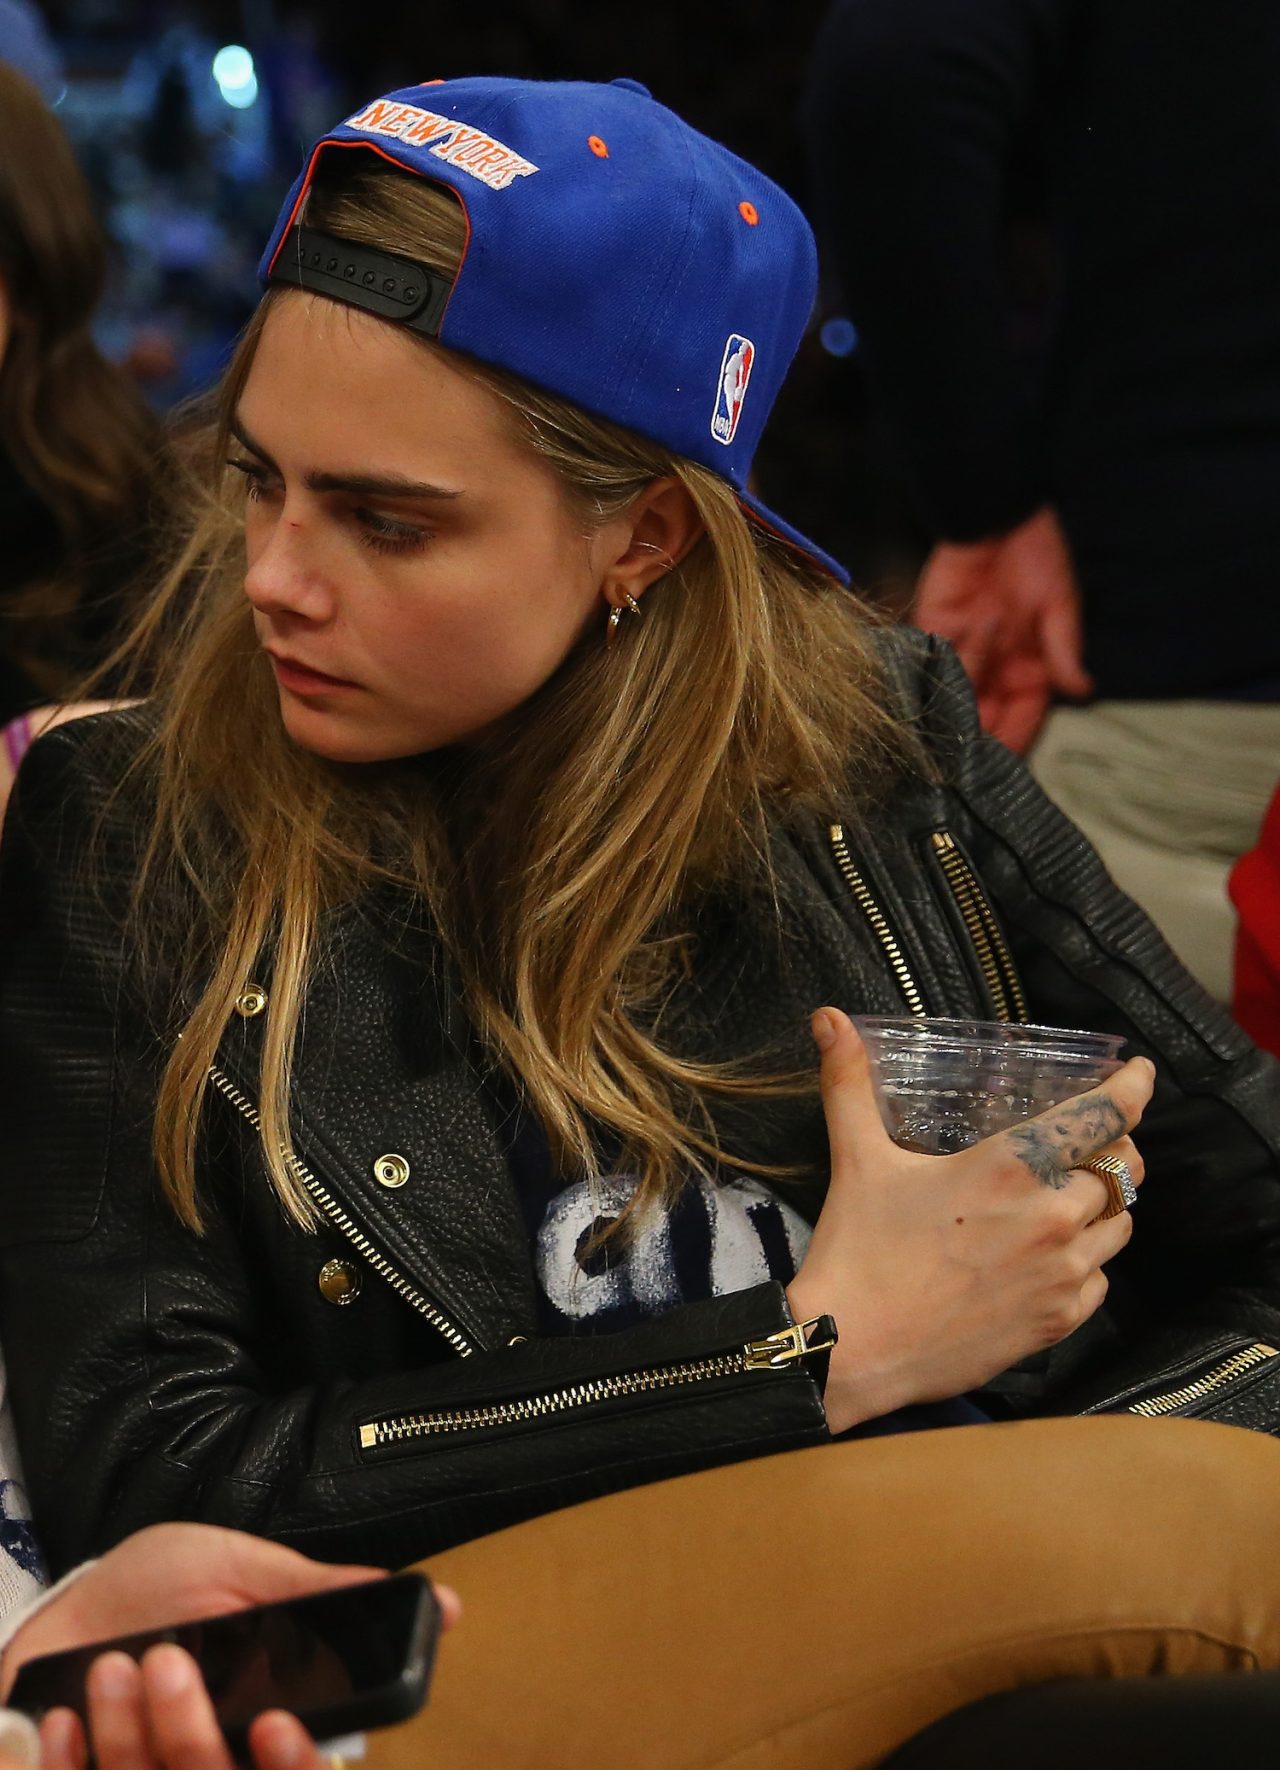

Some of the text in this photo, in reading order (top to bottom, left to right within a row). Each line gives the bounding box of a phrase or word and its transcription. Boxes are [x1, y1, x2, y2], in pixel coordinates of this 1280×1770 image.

[347, 100, 539, 190] NEW YORK
[713, 414, 730, 437] NBA
